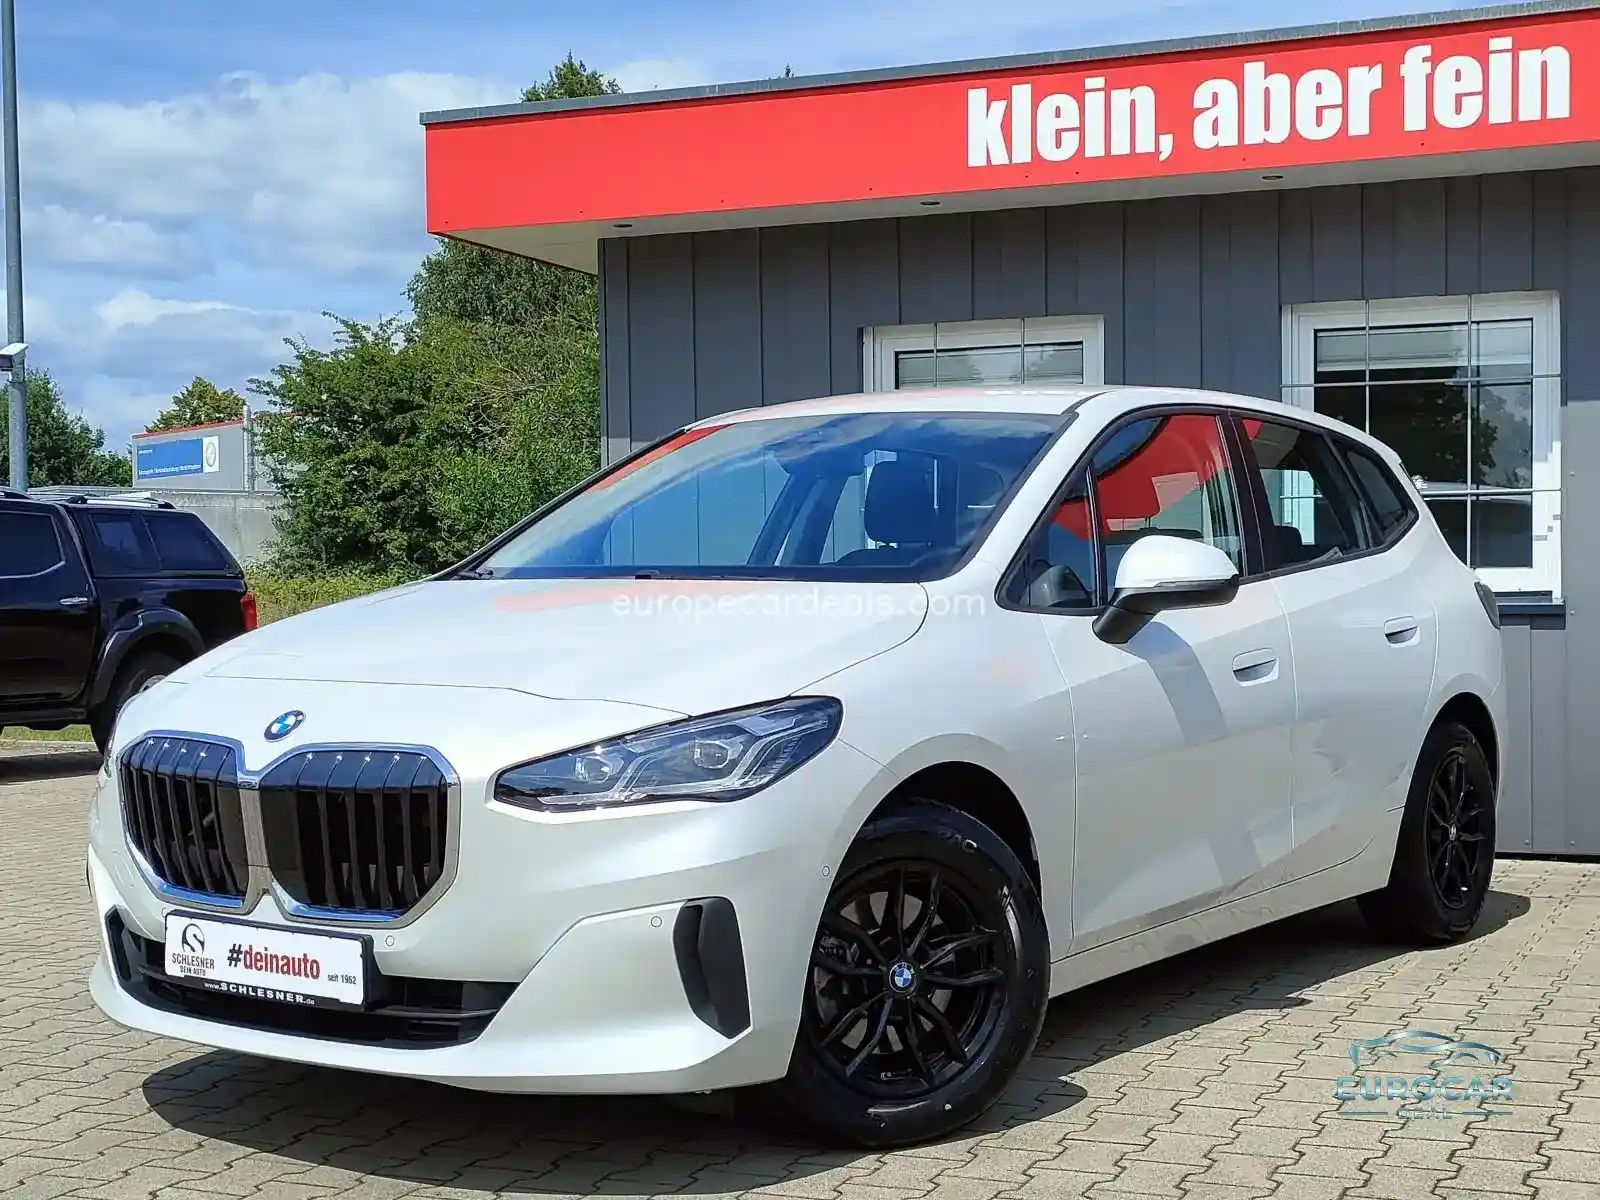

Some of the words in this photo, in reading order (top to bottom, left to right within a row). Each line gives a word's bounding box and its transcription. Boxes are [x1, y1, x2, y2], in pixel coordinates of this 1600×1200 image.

[967, 76, 1174, 169] klein,
[1193, 61, 1383, 150] aber
[1400, 36, 1571, 132] fein
[171, 952, 215, 970] SCHLESNER
[227, 943, 321, 980] #deinauto
[327, 973, 339, 983] seit
[340, 974, 357, 985] 1962
[204, 981, 315, 1005] www.SCHLESNER.de
